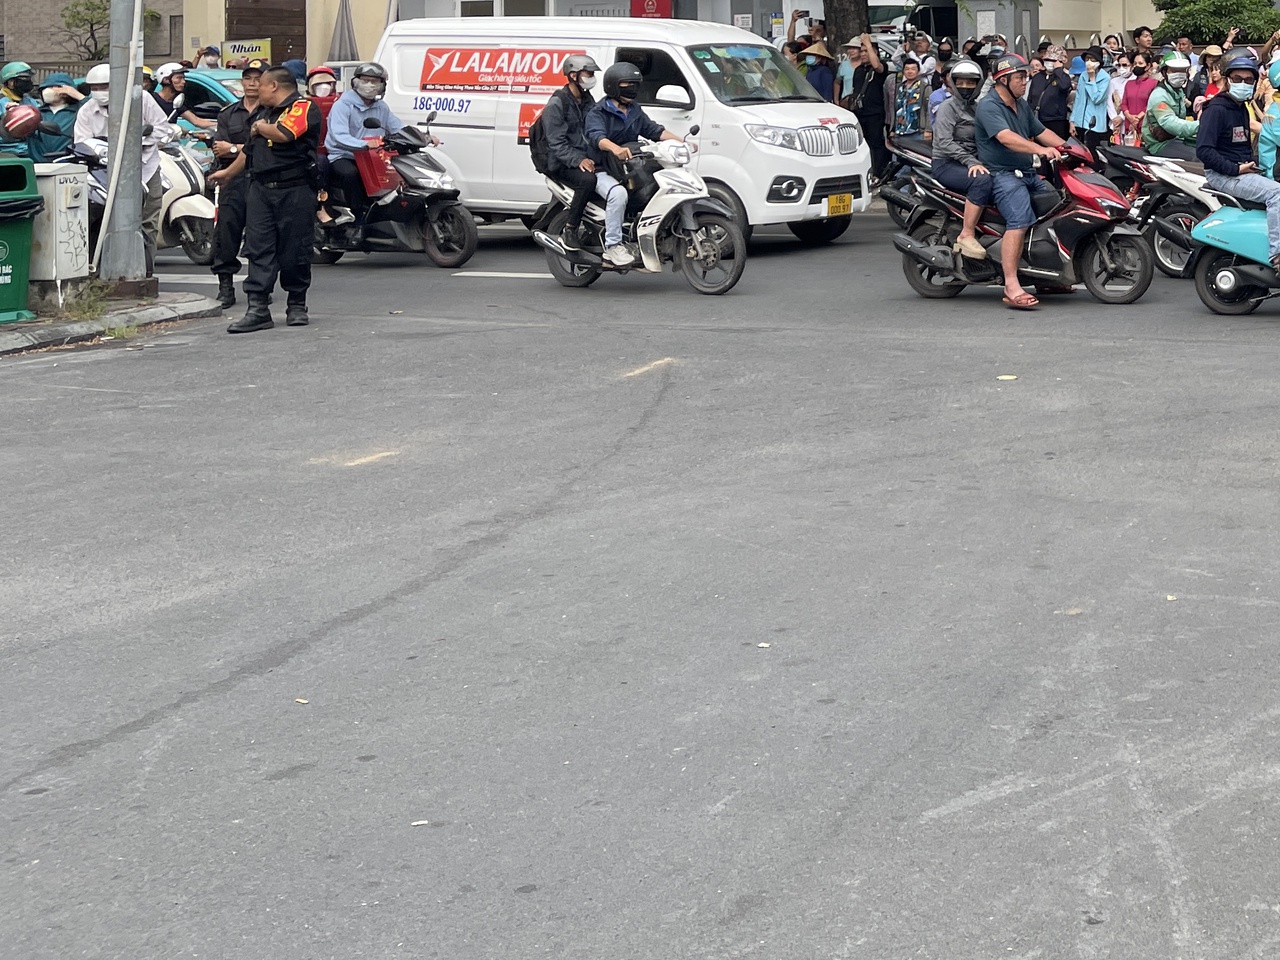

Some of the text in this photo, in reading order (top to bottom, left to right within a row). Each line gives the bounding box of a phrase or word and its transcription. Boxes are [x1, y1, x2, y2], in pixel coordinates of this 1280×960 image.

[450, 52, 571, 74] LALAMOV
[413, 96, 471, 113] 18G-000.97
[835, 195, 846, 204] 18G
[830, 203, 849, 215] 000.97
